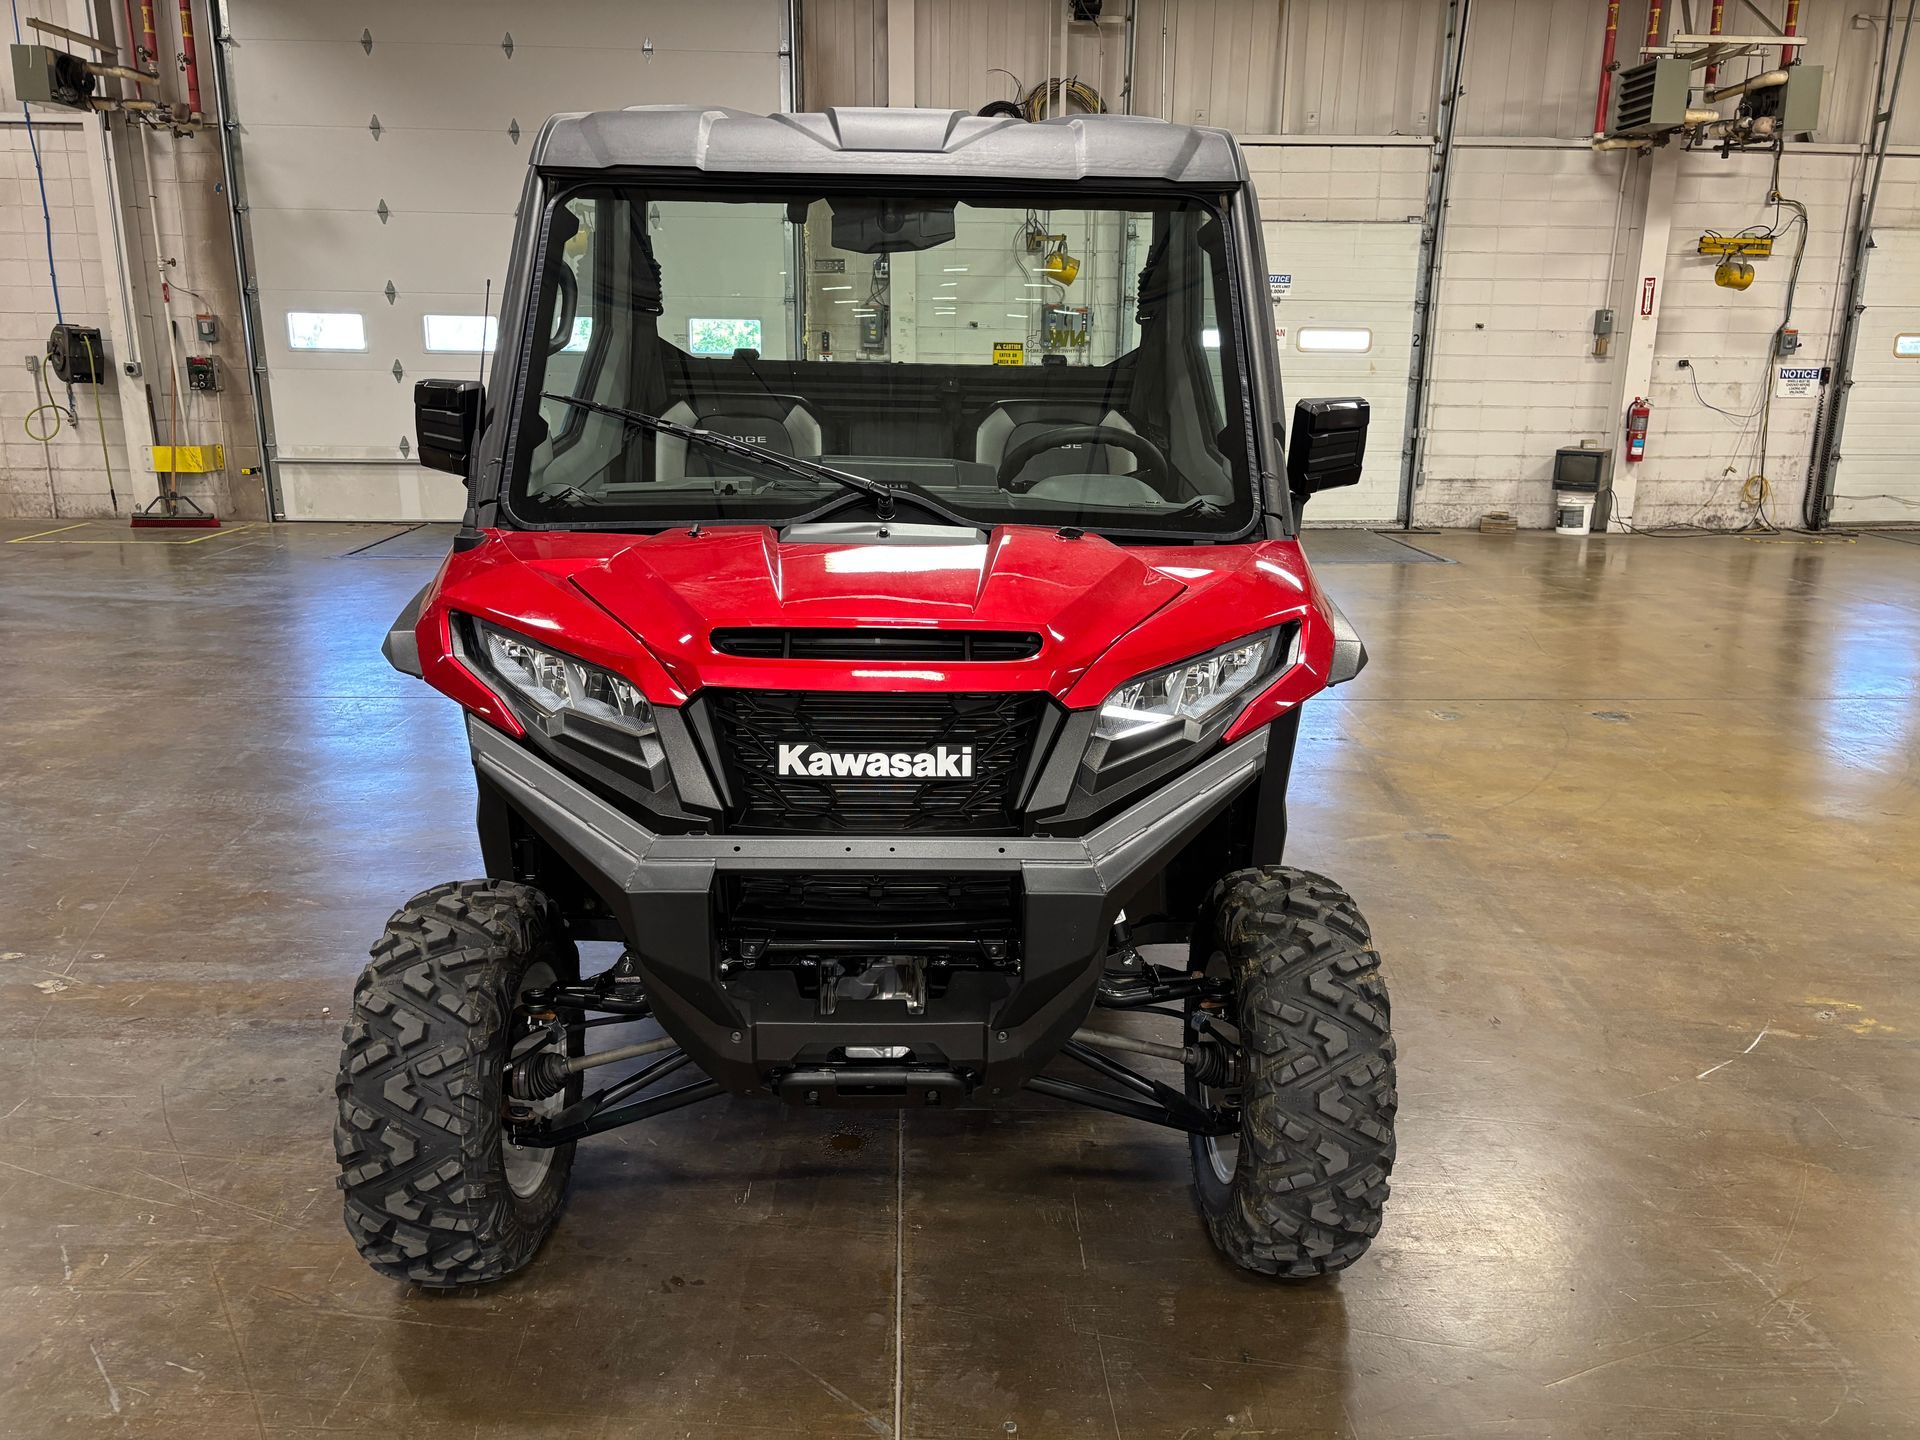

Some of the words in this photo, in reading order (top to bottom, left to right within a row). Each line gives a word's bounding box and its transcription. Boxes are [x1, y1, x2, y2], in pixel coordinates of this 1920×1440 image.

[1412, 333, 1420, 347] 2
[1782, 370, 1818, 378] NOTICE
[733, 435, 767, 443] DGE
[778, 744, 972, 778] Kawasaki
